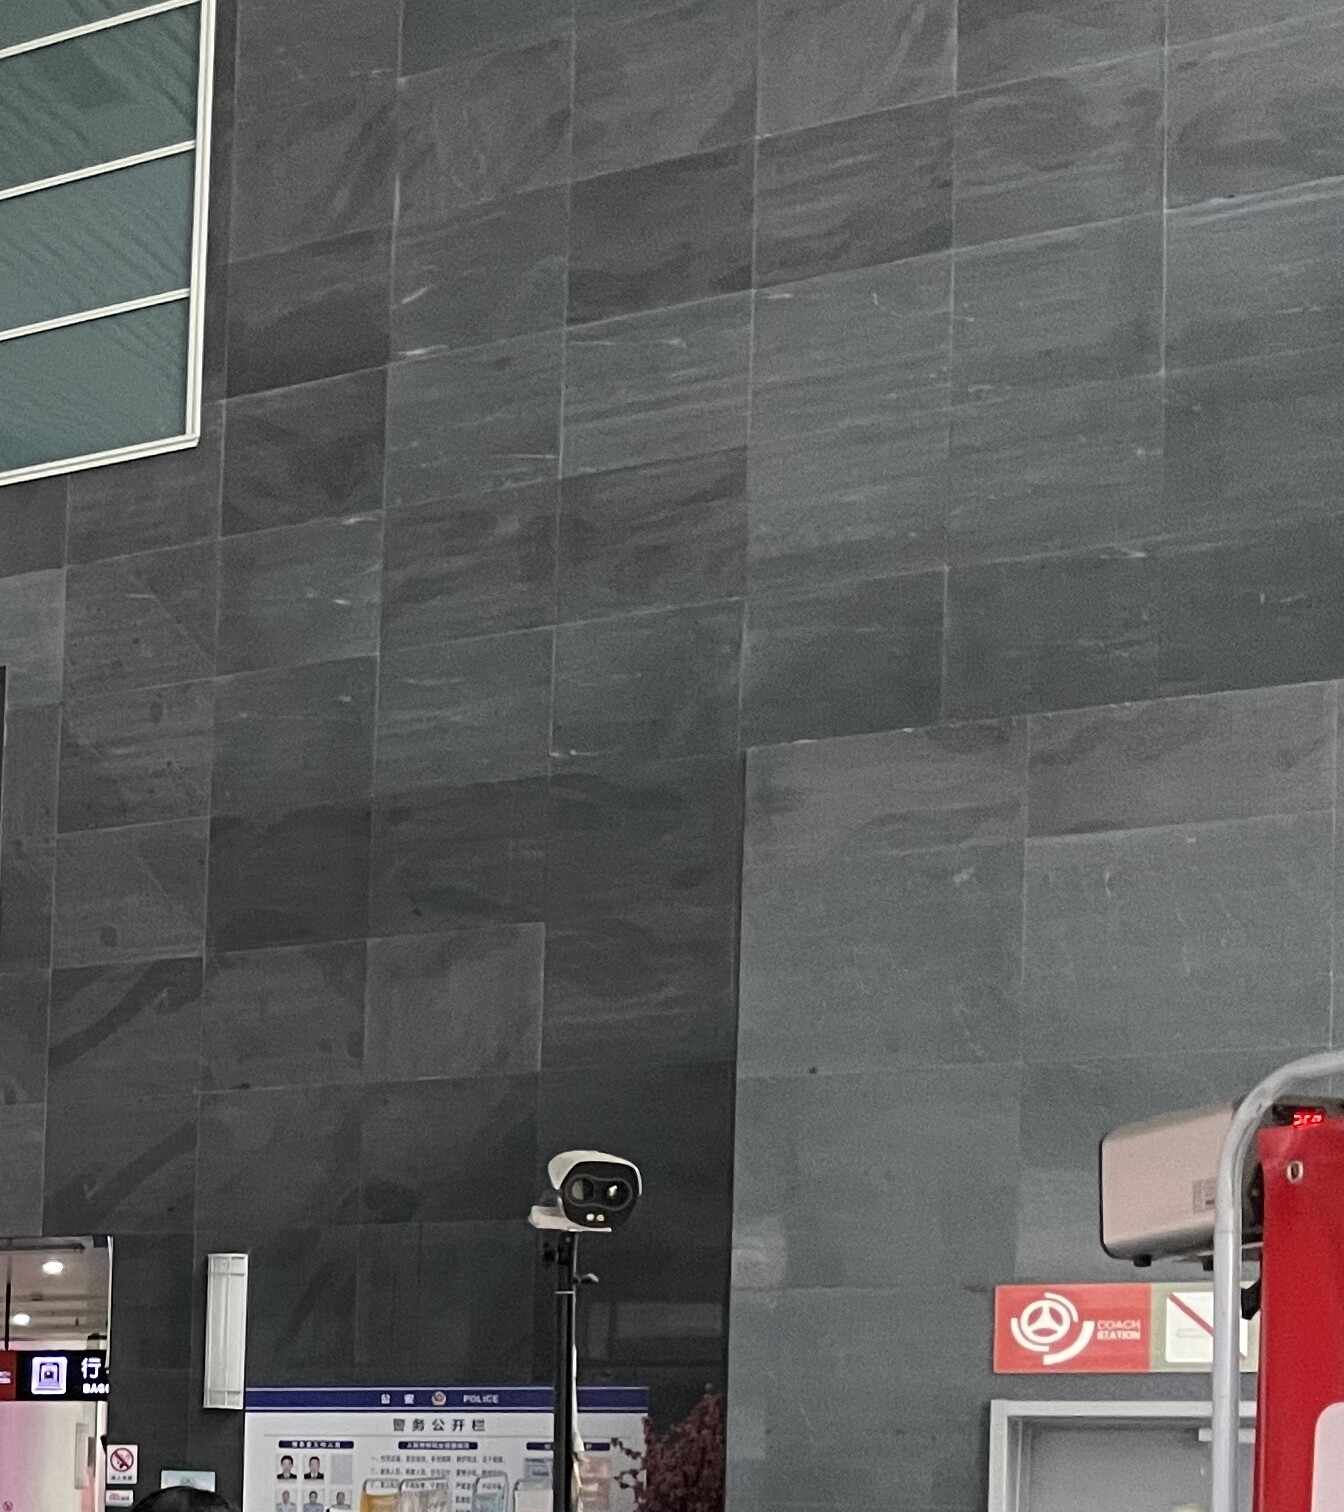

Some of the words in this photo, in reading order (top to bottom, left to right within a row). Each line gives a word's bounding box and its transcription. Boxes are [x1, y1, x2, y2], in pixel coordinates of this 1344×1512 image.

[1097, 1319, 1141, 1331] COACH
[1096, 1331, 1141, 1341] STATION
[463, 1394, 500, 1404] POLICE
[392, 1417, 486, 1433] 警务公开栏
